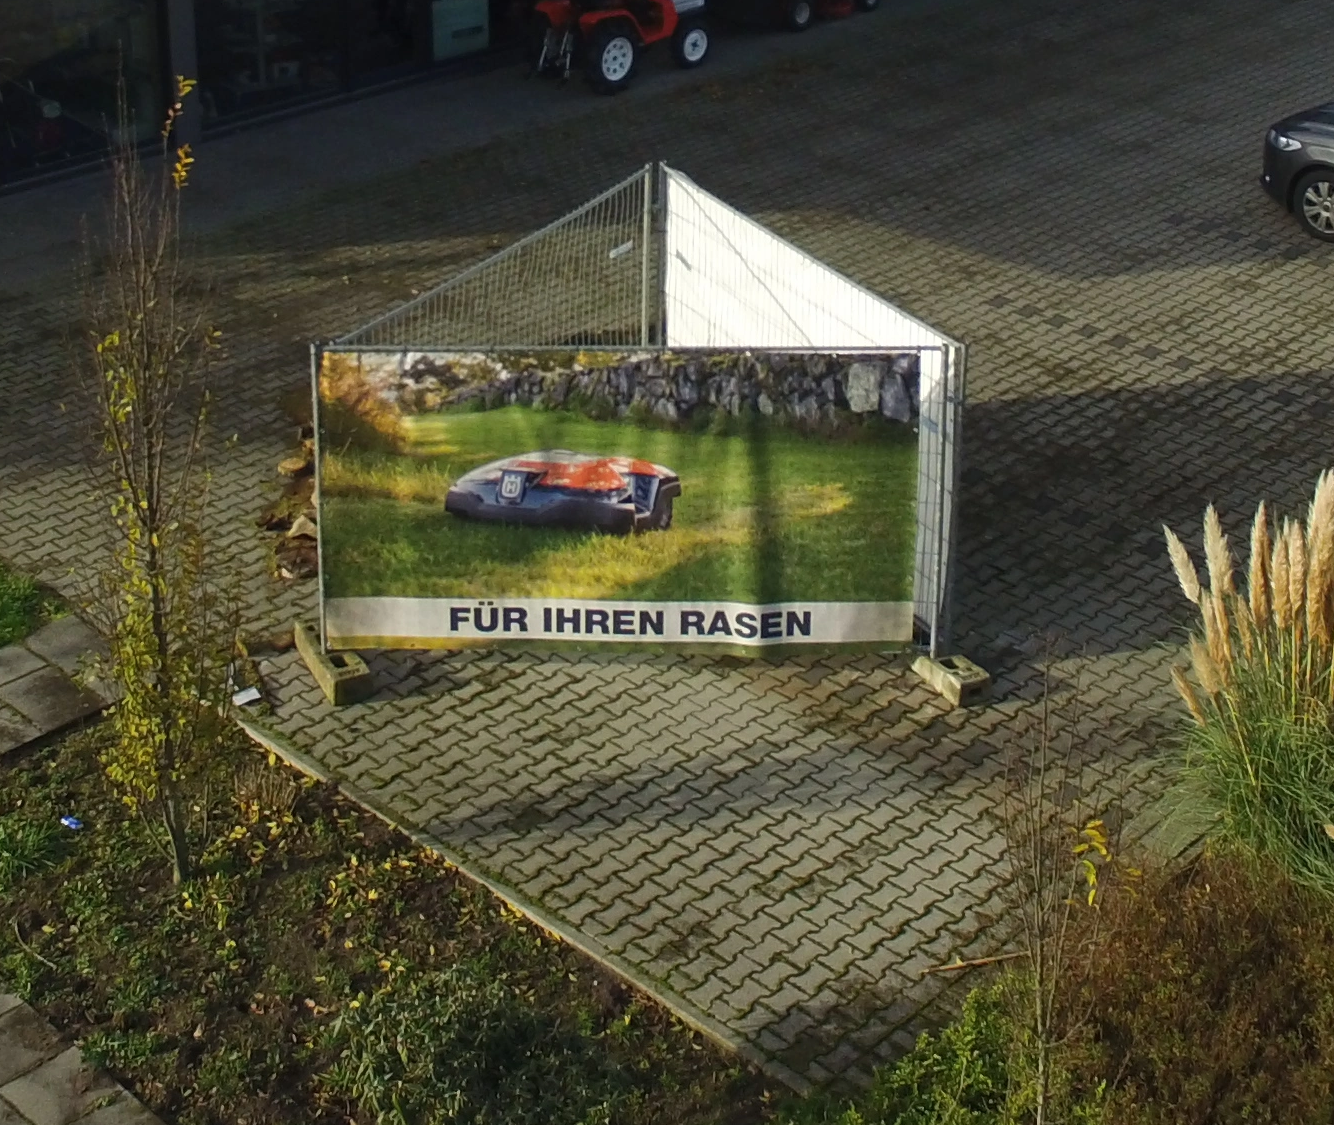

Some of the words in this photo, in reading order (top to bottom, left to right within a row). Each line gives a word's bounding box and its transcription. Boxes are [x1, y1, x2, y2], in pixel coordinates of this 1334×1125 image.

[450, 601, 528, 632] FÜR
[543, 607, 664, 635] IHREN
[680, 610, 811, 639] RASEN
